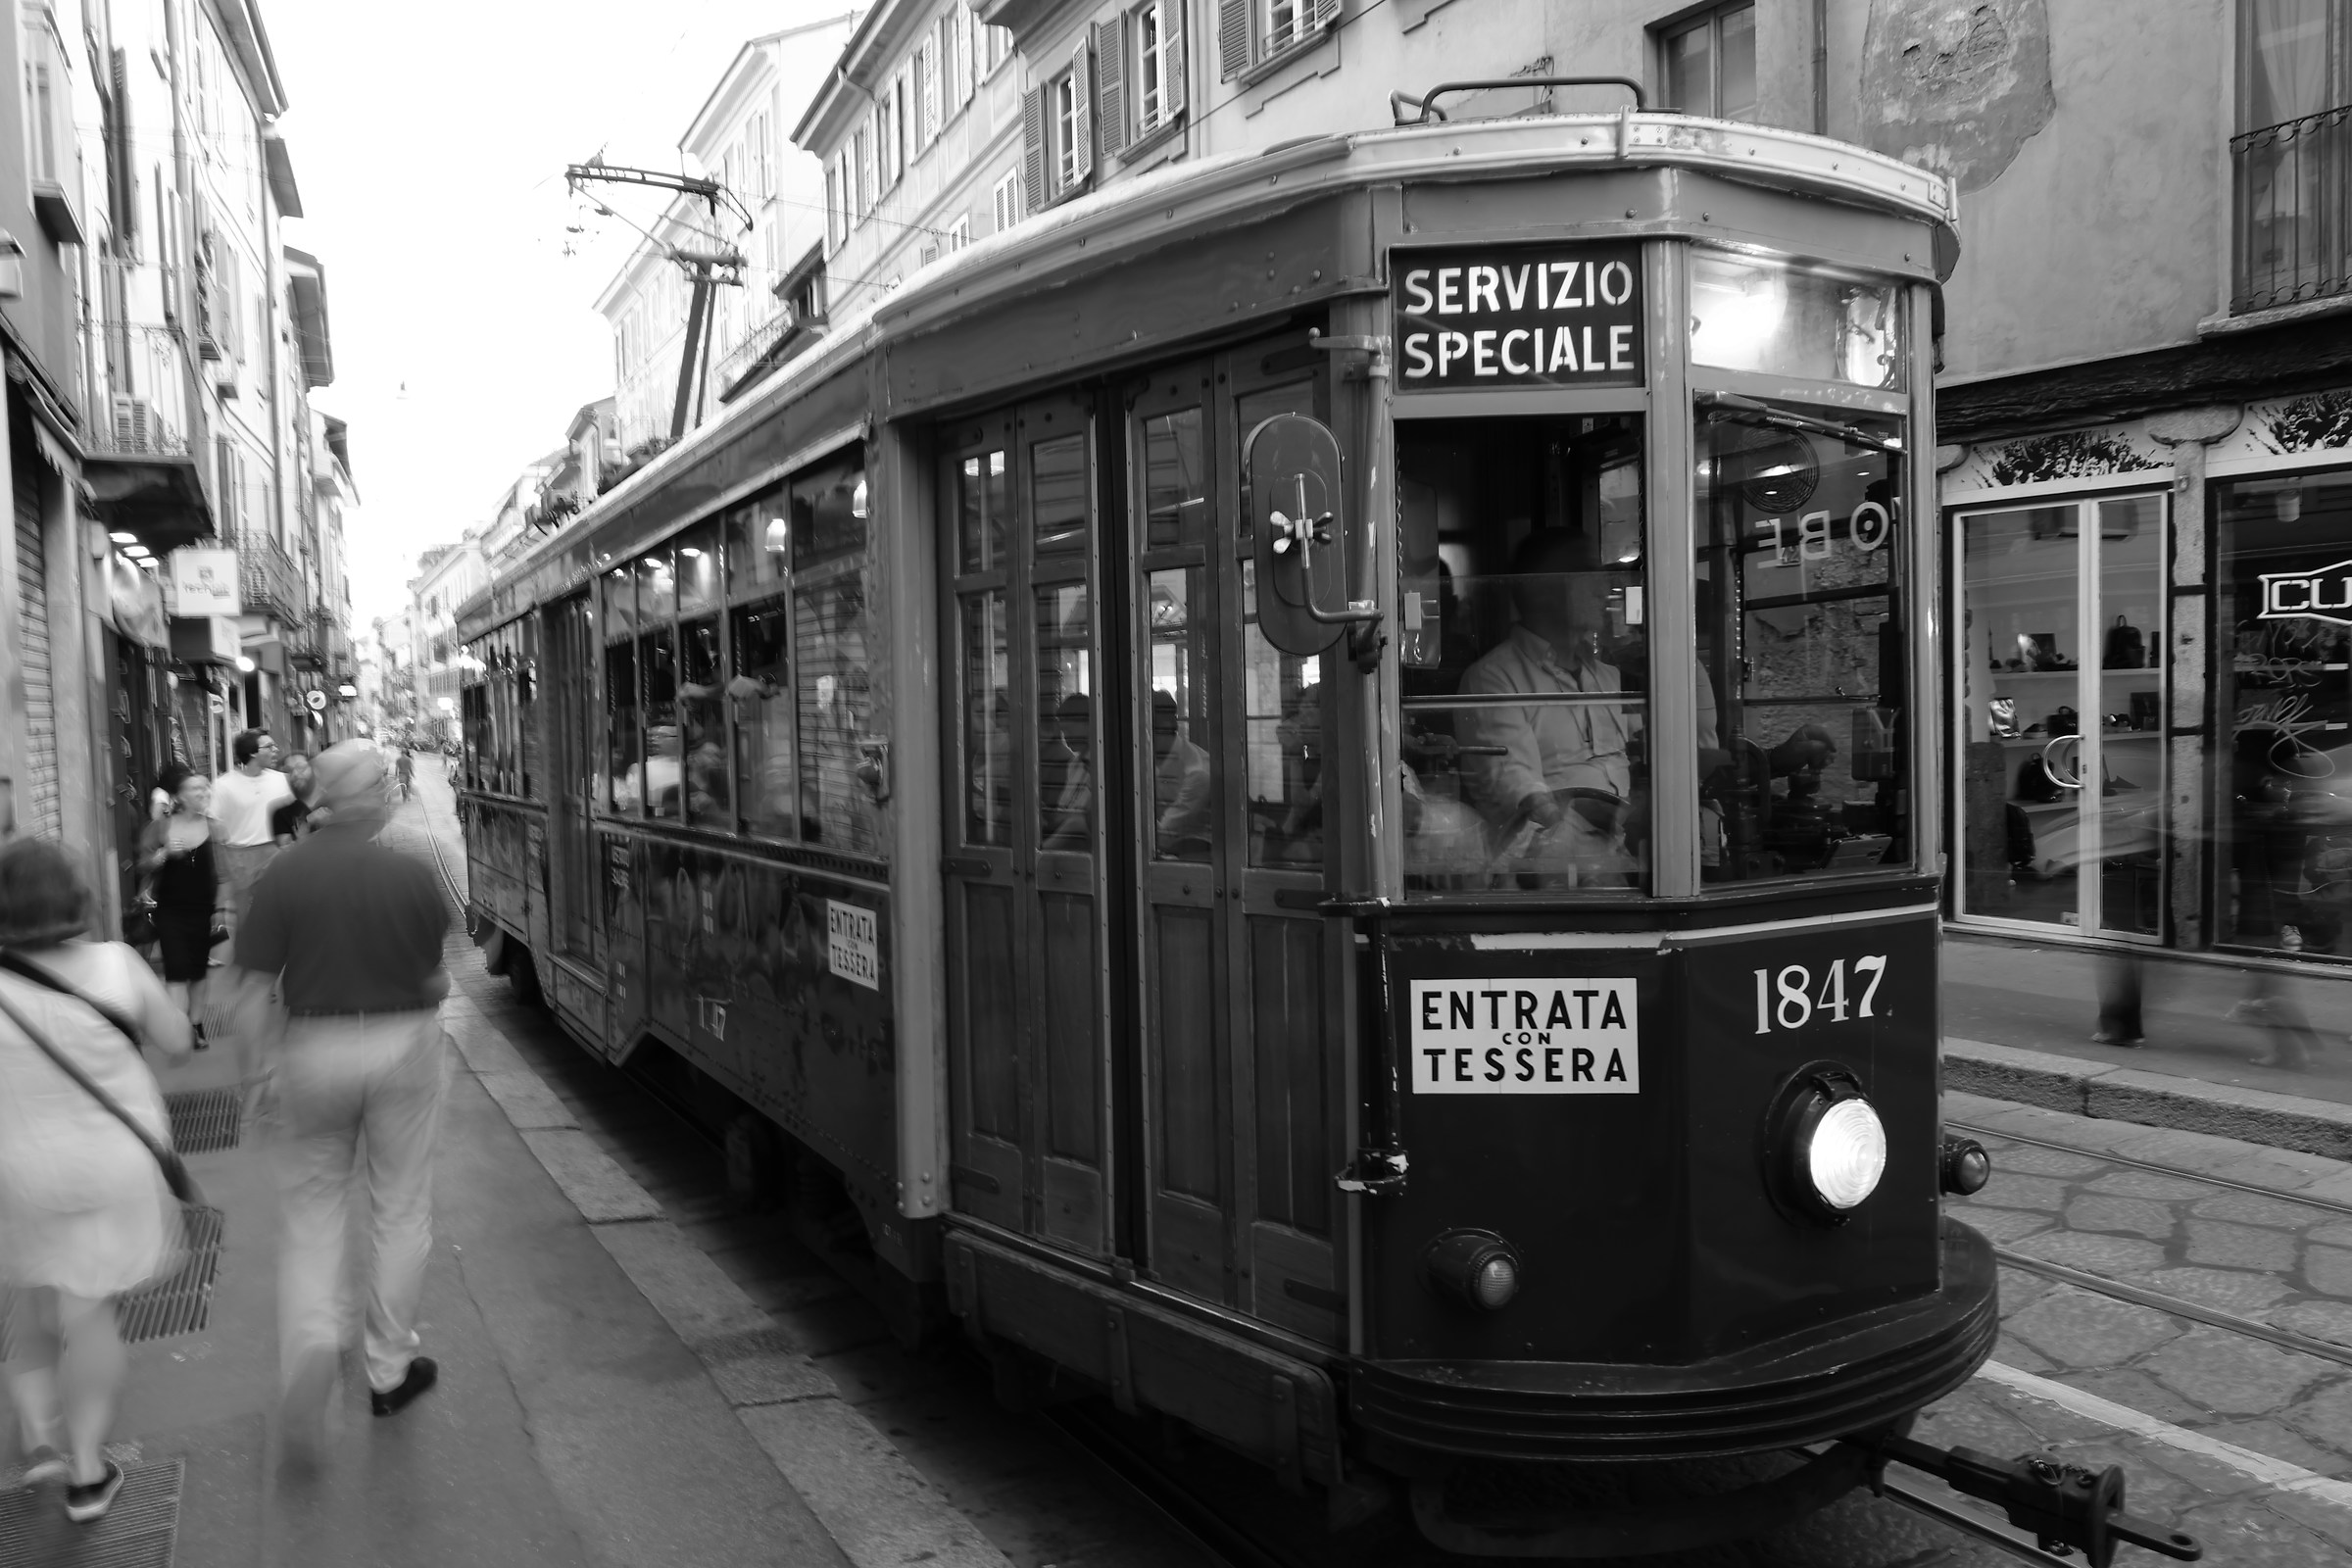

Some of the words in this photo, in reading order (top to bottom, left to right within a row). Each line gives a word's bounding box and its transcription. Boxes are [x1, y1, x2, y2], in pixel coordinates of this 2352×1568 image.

[1404, 261, 1633, 315] SERVIZIO
[1404, 325, 1634, 378] SPECIALE
[831, 906, 875, 947] ENTRATA
[831, 944, 876, 982] TESSERA
[1422, 990, 1627, 1030] ENTRATA
[1753, 955, 1886, 1034] 1847
[1502, 1032, 1550, 1045] CON
[1422, 1048, 1627, 1082] TESSERA
